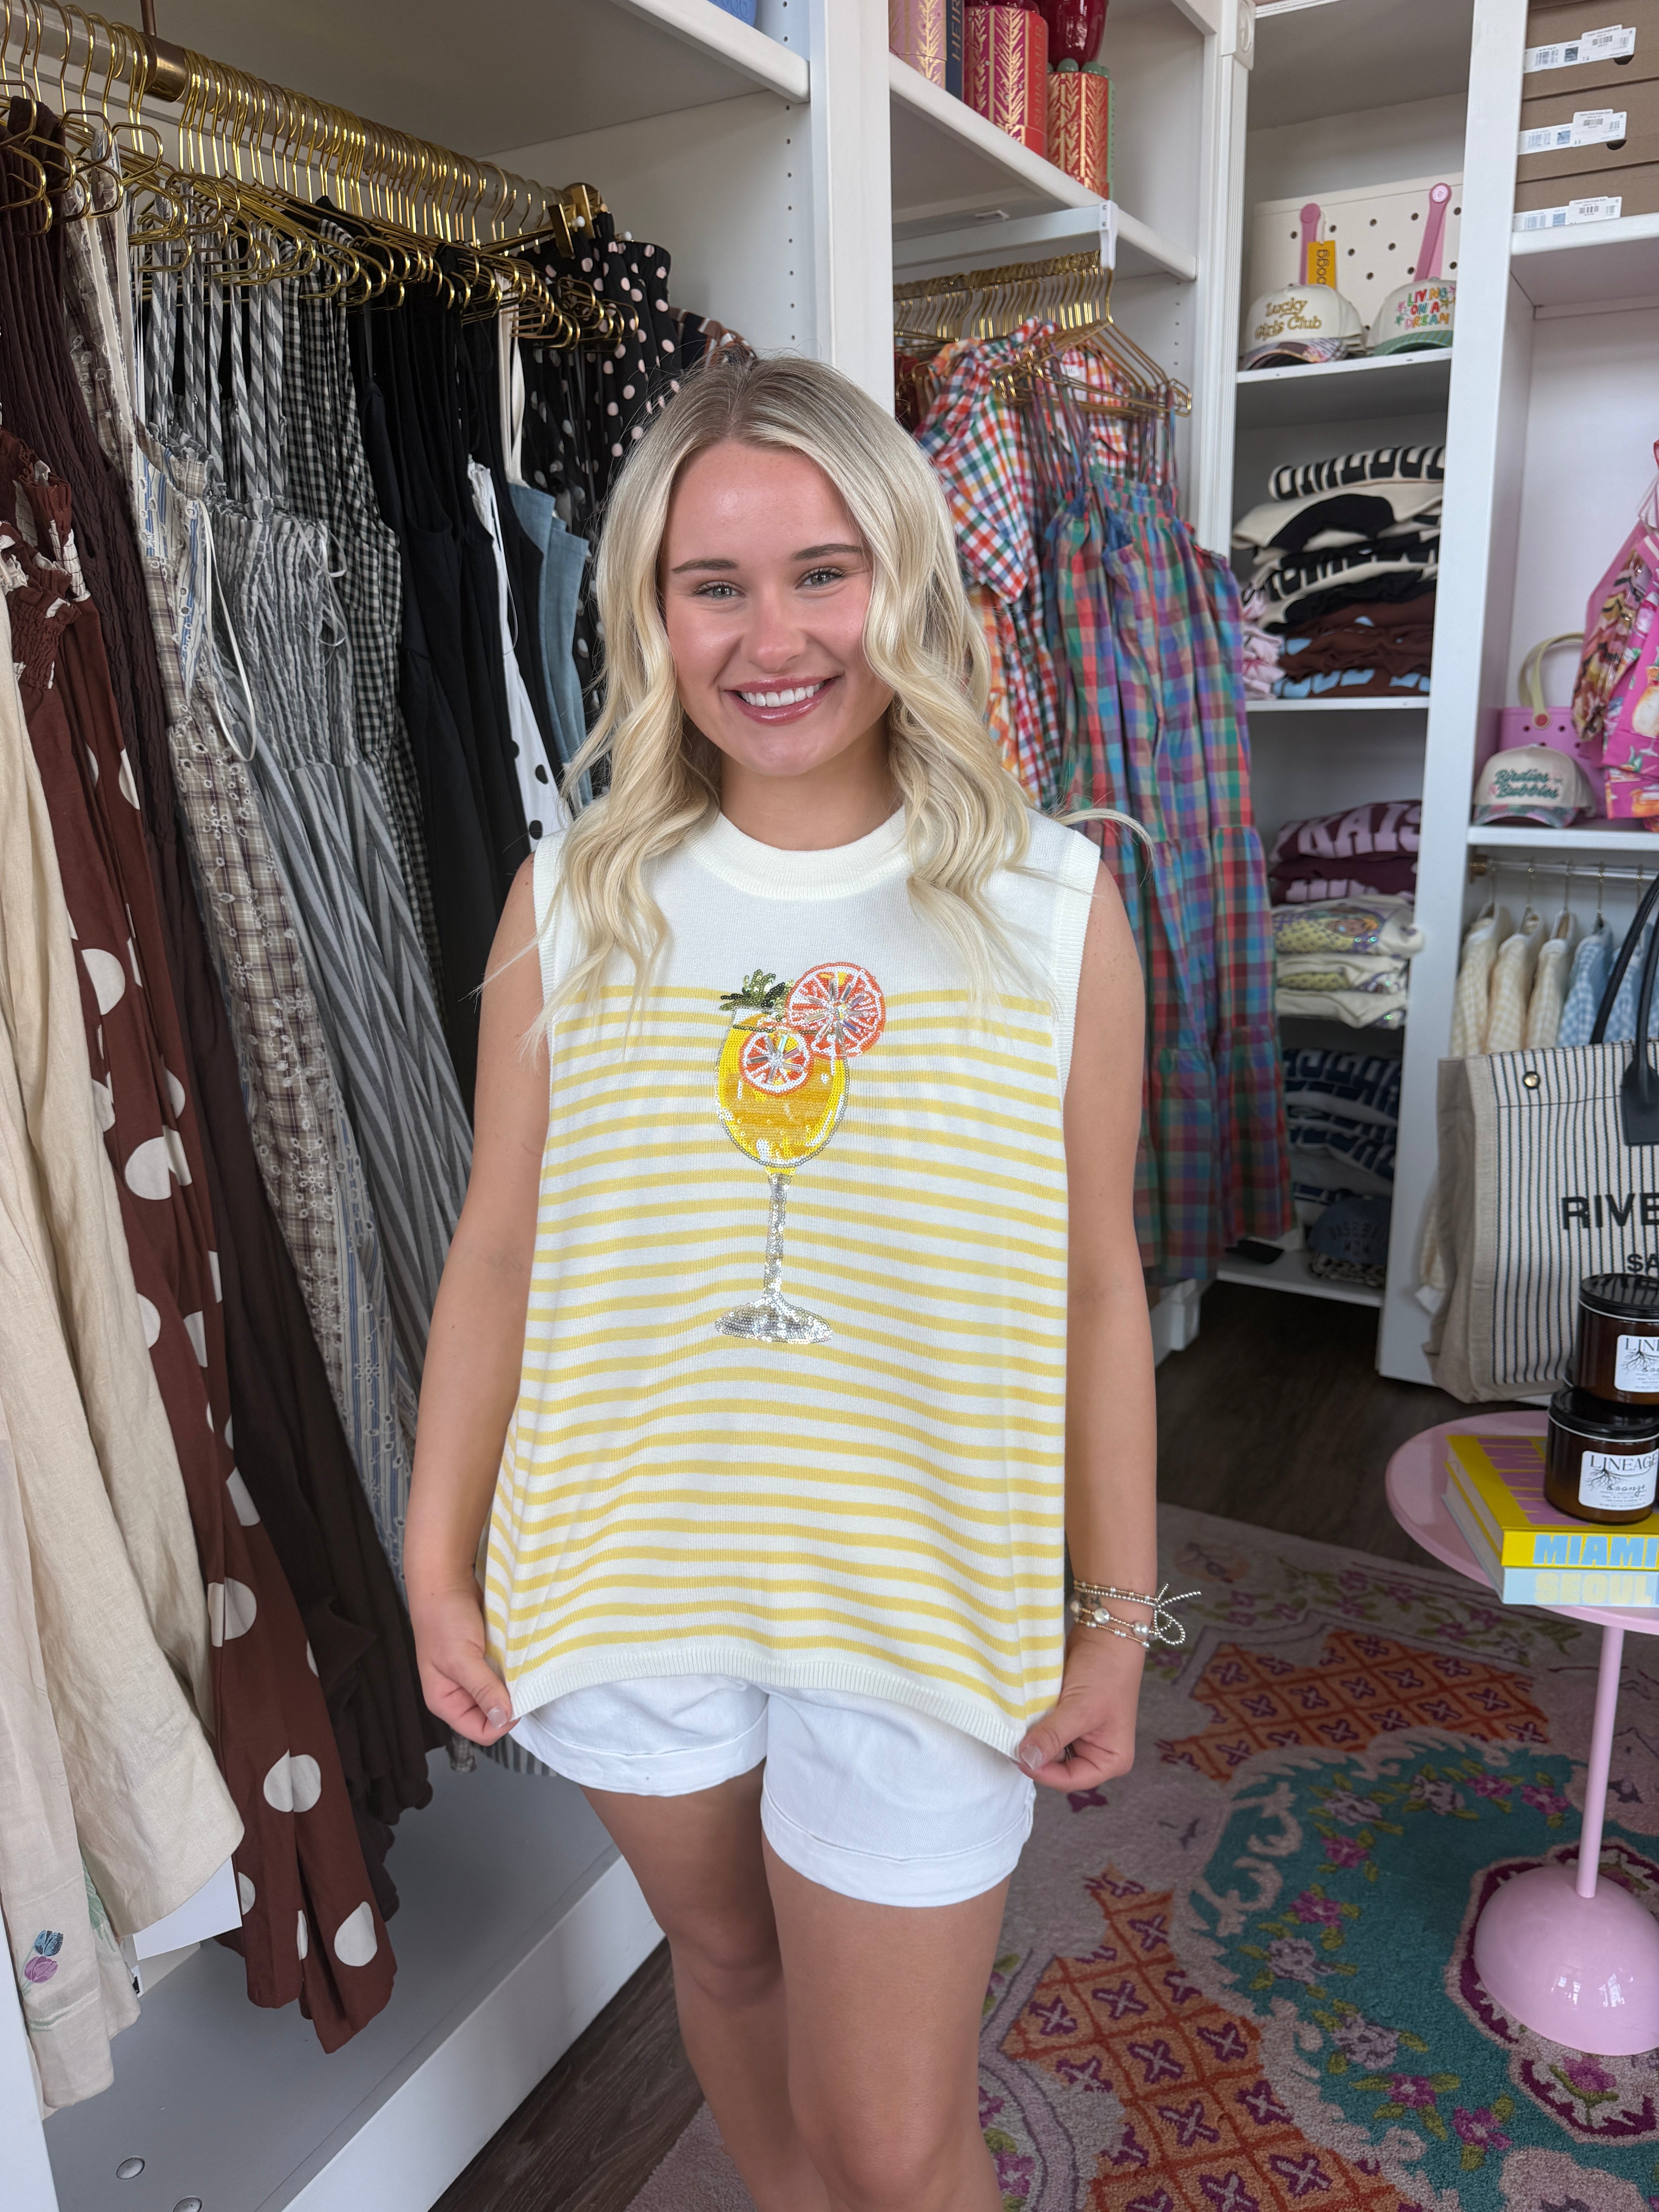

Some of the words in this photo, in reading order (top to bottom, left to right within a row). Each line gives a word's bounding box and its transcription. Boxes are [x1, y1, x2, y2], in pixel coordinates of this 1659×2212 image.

[1407, 287, 1448, 307] LIVING
[1265, 297, 1308, 318] Lucky
[1410, 303, 1428, 315] ON
[1430, 301, 1440, 314] A
[1287, 315, 1322, 330] Club
[1404, 313, 1450, 330] DREAM
[1561, 1193, 1659, 1230] RIVE
[1625, 1338, 1659, 1352] LIN
[1590, 1452, 1659, 1472] LINEAGE
[1532, 1534, 1659, 1568] MIAMI
[1535, 1572, 1652, 1605] SEOUL
